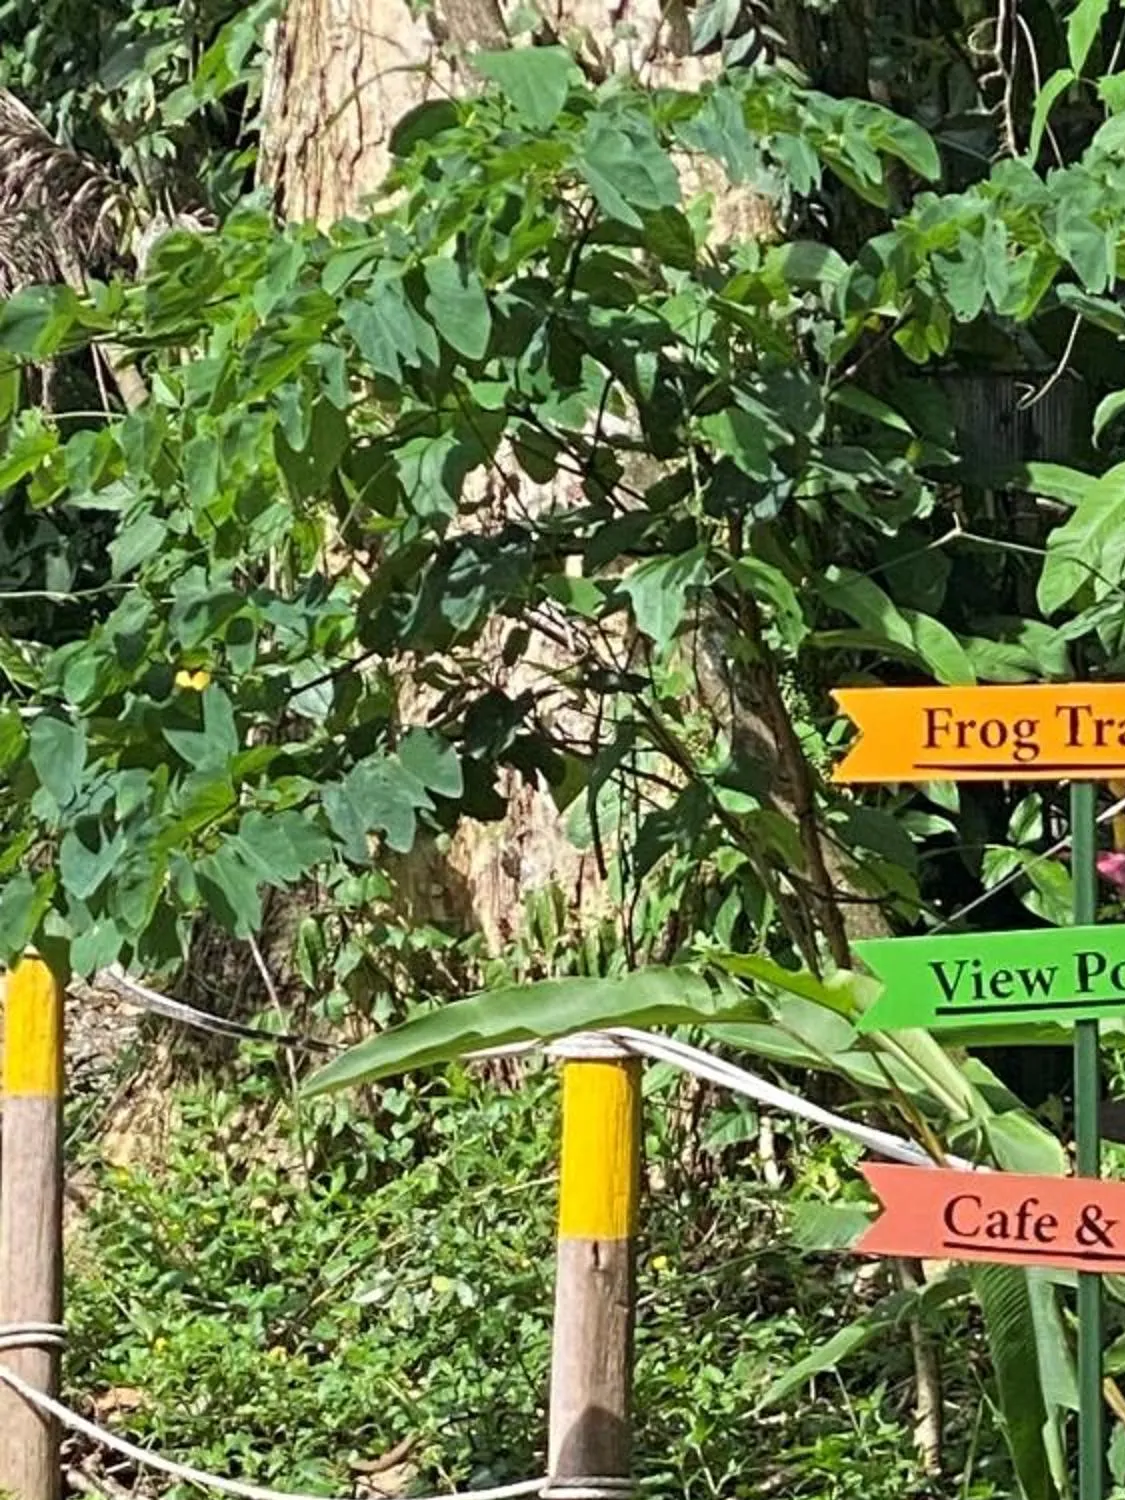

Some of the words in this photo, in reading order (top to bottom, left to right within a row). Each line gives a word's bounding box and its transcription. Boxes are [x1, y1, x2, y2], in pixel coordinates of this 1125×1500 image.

[923, 707, 1040, 761] Frog
[929, 959, 1056, 1001] View
[944, 1195, 1058, 1243] Cafe
[1075, 1204, 1118, 1248] &
